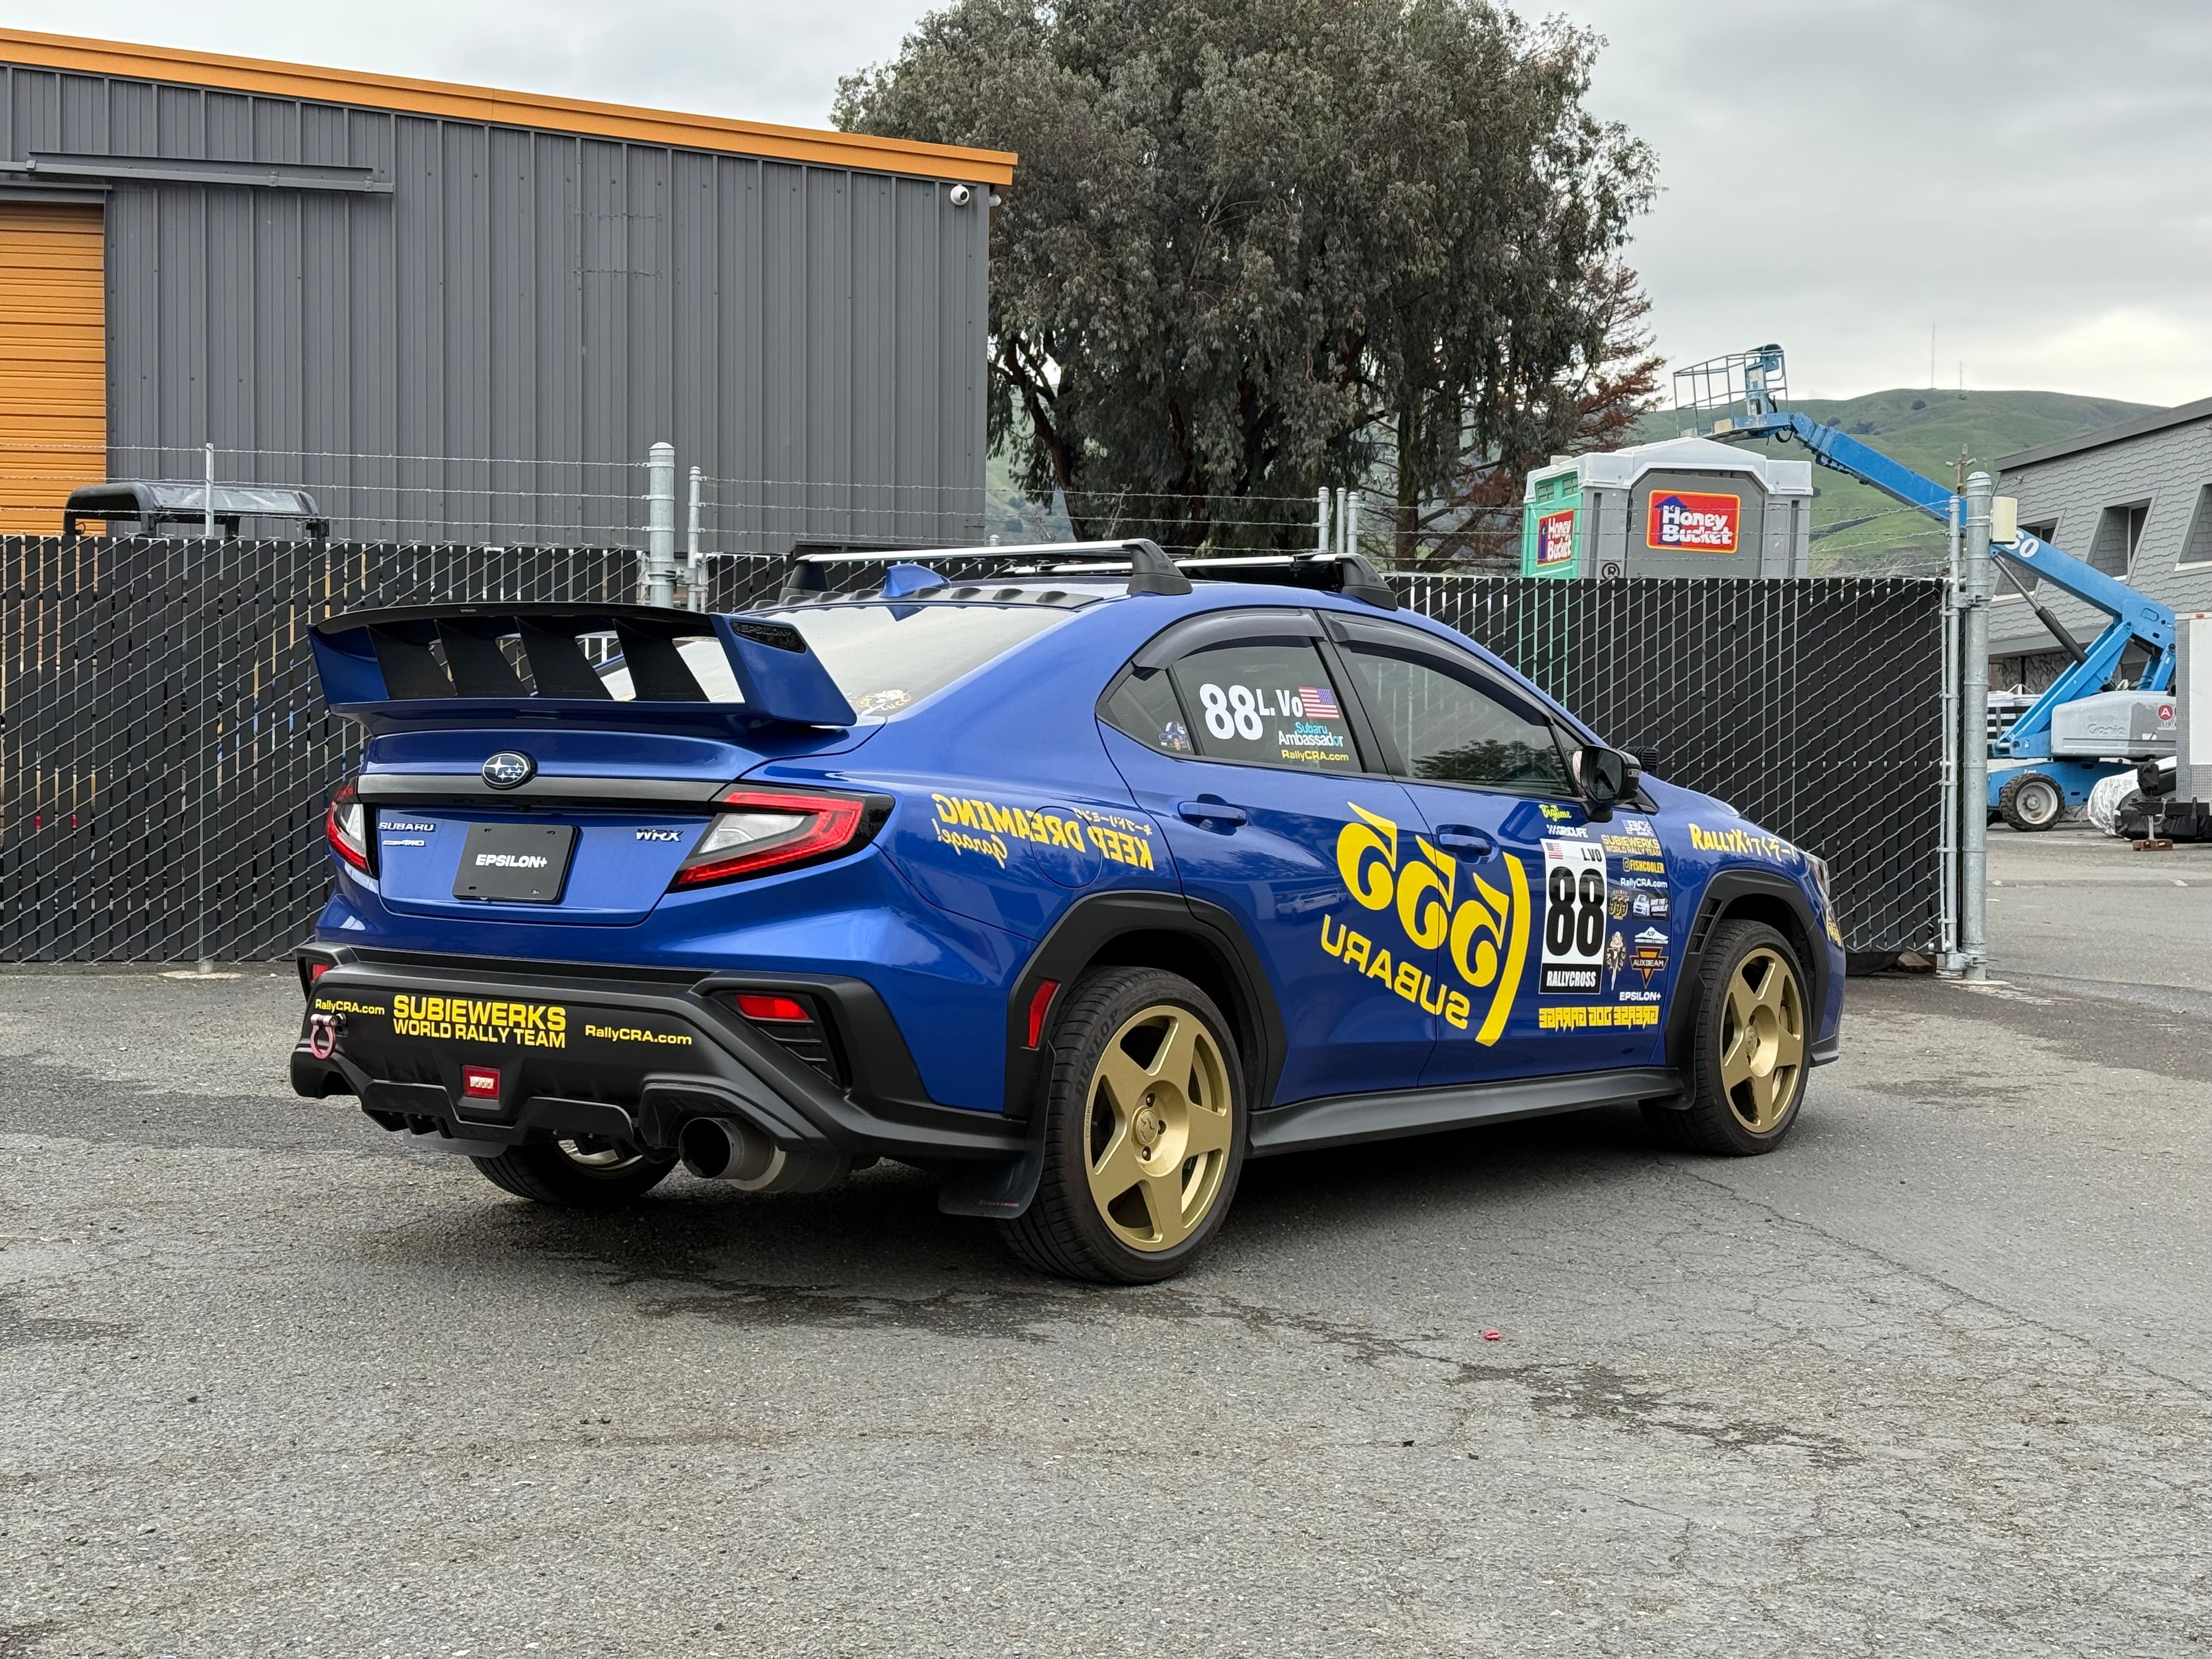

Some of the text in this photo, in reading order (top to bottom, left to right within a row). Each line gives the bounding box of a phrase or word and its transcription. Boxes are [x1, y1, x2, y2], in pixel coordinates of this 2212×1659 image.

[1663, 505, 1728, 531] Honey
[1548, 517, 1571, 541] Honey
[1662, 524, 1733, 545] Bucket
[1547, 537, 1571, 561] Bucket
[1199, 683, 1263, 740] 88
[1276, 689, 1304, 718] Vo
[1295, 721, 1328, 734] Subaru
[1278, 730, 1344, 747] Ambassador
[1281, 749, 1350, 762] RallyCRA.com
[378, 822, 435, 831] SUBARU
[636, 829, 683, 842] WRX
[1601, 834, 1660, 849] SUBIEWERKS
[1605, 845, 1662, 857] WORLD RALLY TEAM
[476, 854, 548, 868] EPSILON+
[1620, 877, 1668, 888] RallyCRA.com
[1546, 867, 1606, 958] 88
[1546, 971, 1596, 987] RALLYCROSS
[315, 998, 385, 1015] RallyCRA.com
[393, 995, 566, 1029] SUBIEWERKS
[393, 1019, 566, 1049] WORLD RALLY TEAM
[585, 1024, 692, 1046] RallyCRA.com
